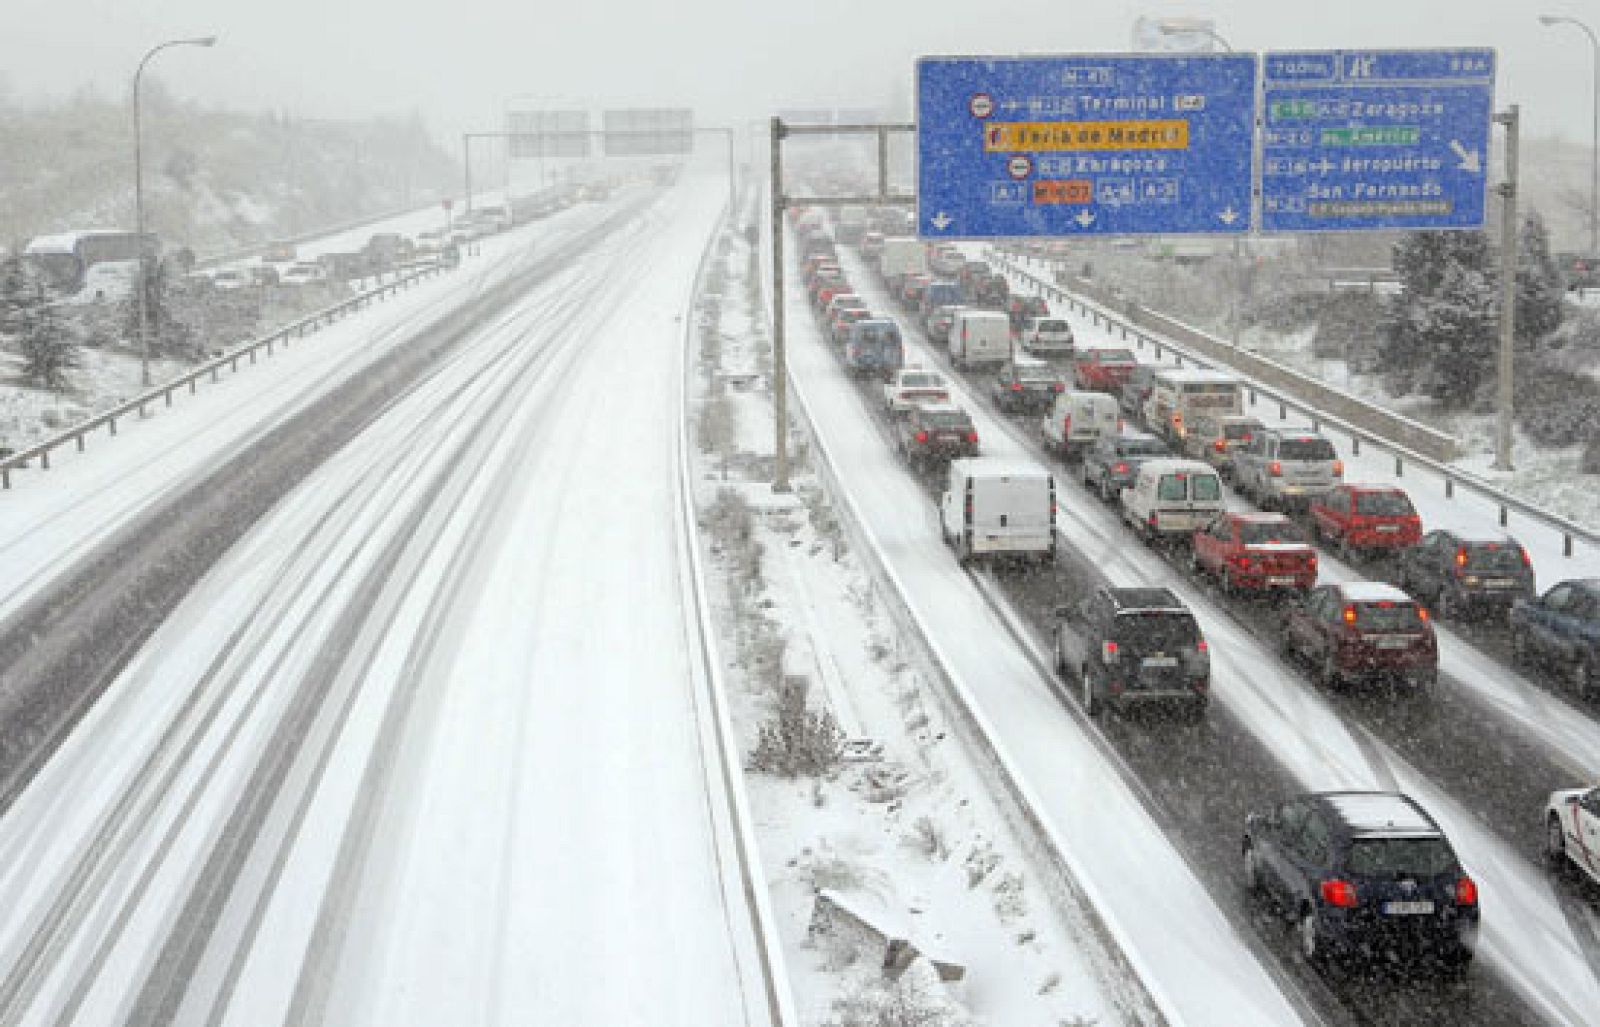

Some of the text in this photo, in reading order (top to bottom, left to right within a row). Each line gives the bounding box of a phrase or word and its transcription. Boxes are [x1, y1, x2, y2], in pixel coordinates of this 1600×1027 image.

[1081, 95, 1164, 112] Terminal
[1352, 101, 1444, 119] Zaragoza
[1343, 157, 1442, 175] Aeropuerto
